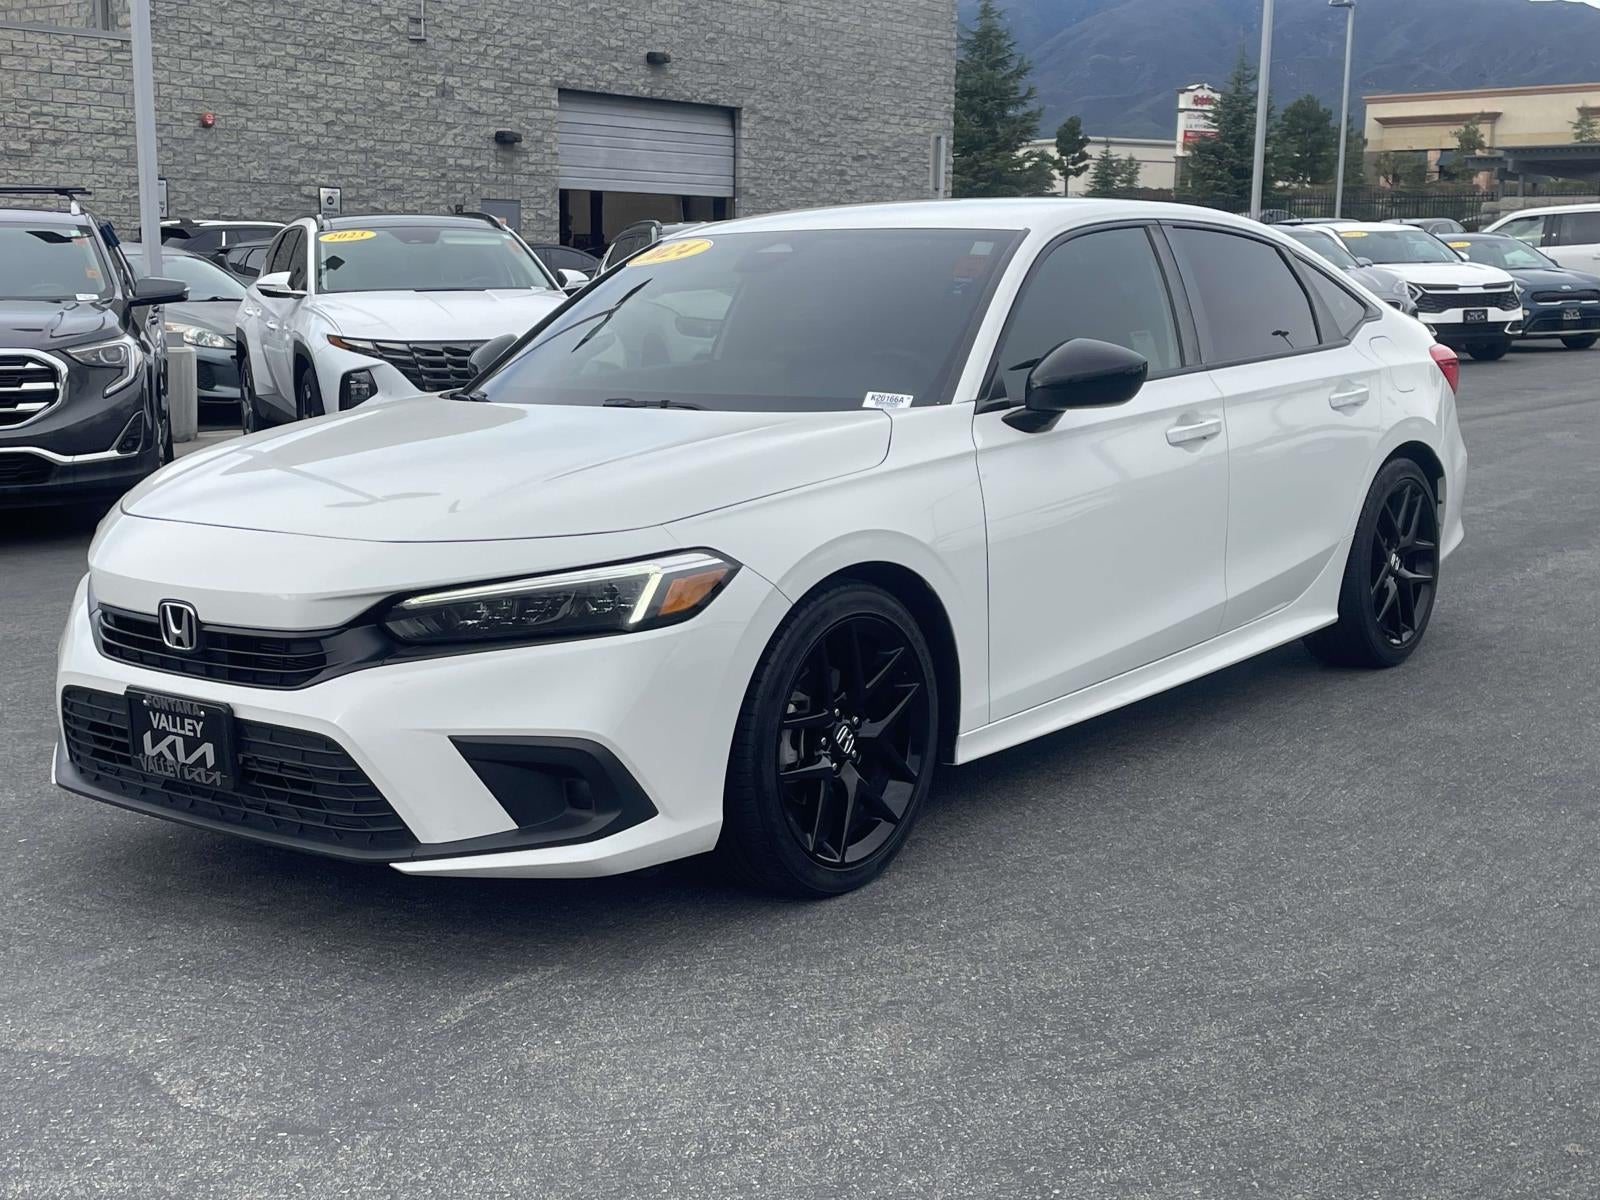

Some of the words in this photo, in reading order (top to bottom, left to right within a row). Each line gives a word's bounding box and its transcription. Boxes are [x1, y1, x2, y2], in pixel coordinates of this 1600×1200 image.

[327, 231, 367, 241] 2023
[870, 394, 905, 404] K20166A
[149, 711, 204, 738] VALLEY
[143, 730, 215, 769] KIA
[139, 753, 182, 779] VALLEY
